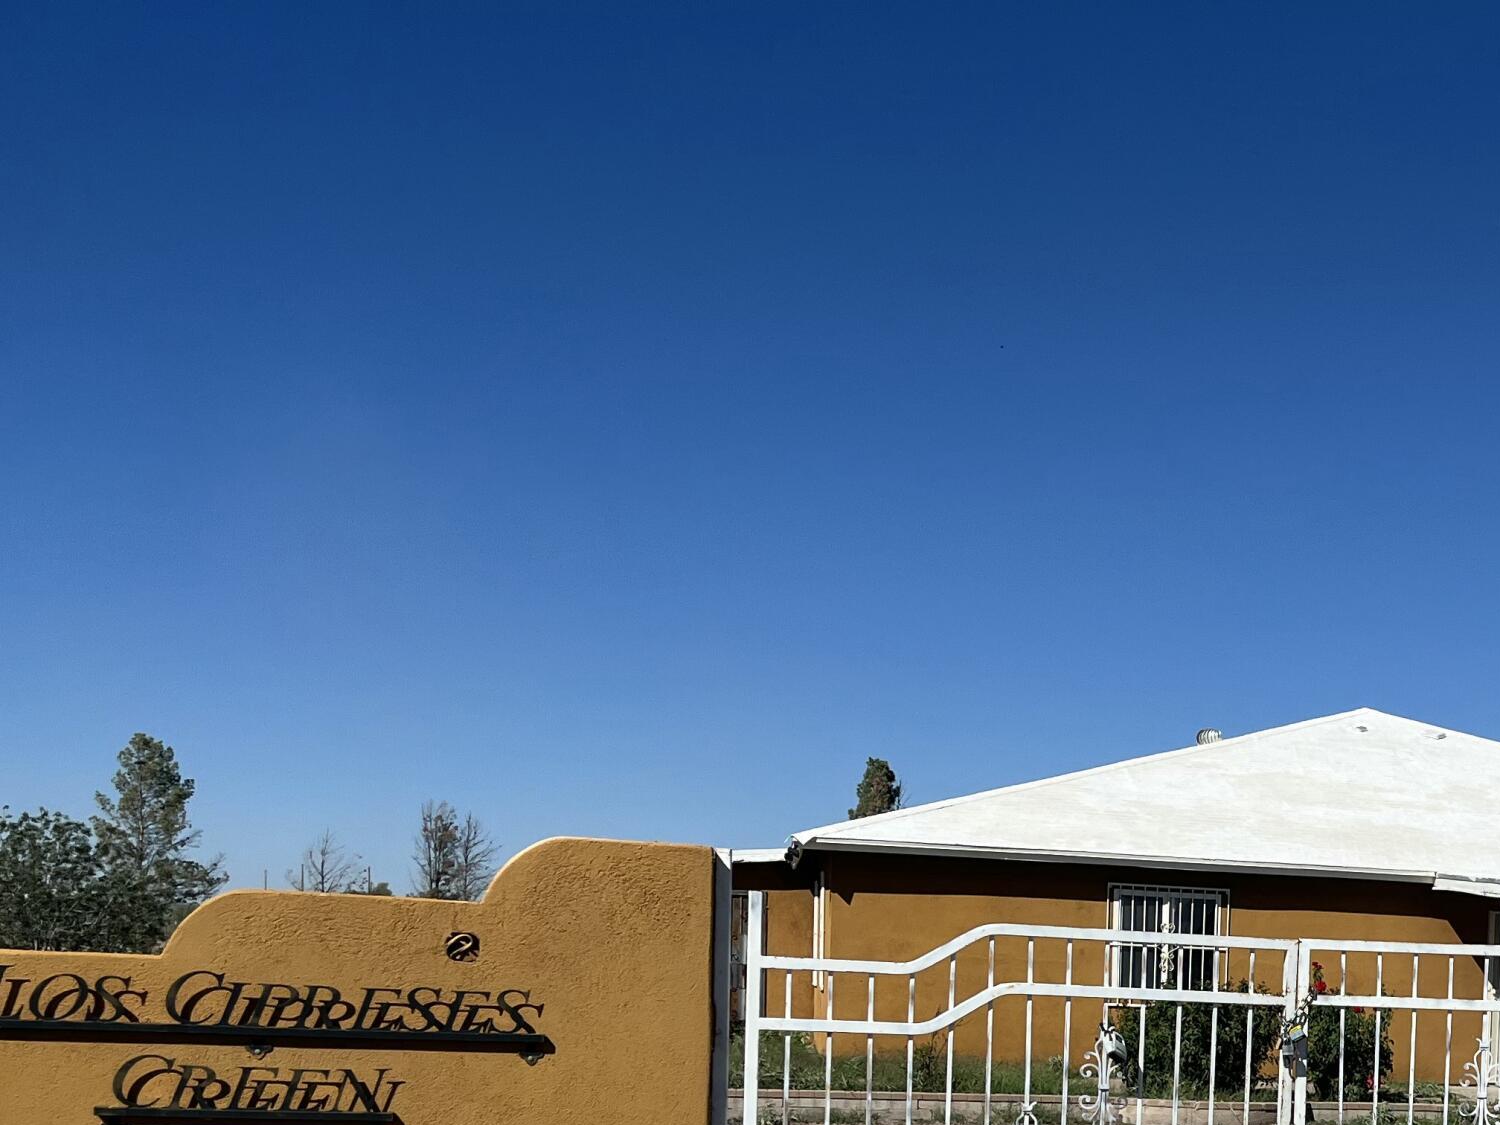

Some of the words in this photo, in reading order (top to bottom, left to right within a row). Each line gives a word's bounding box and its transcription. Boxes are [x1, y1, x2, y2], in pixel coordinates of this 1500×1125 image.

[0, 965, 134, 1022] OS
[166, 970, 538, 1034] CIPRESES
[112, 1054, 392, 1112] CREEN
